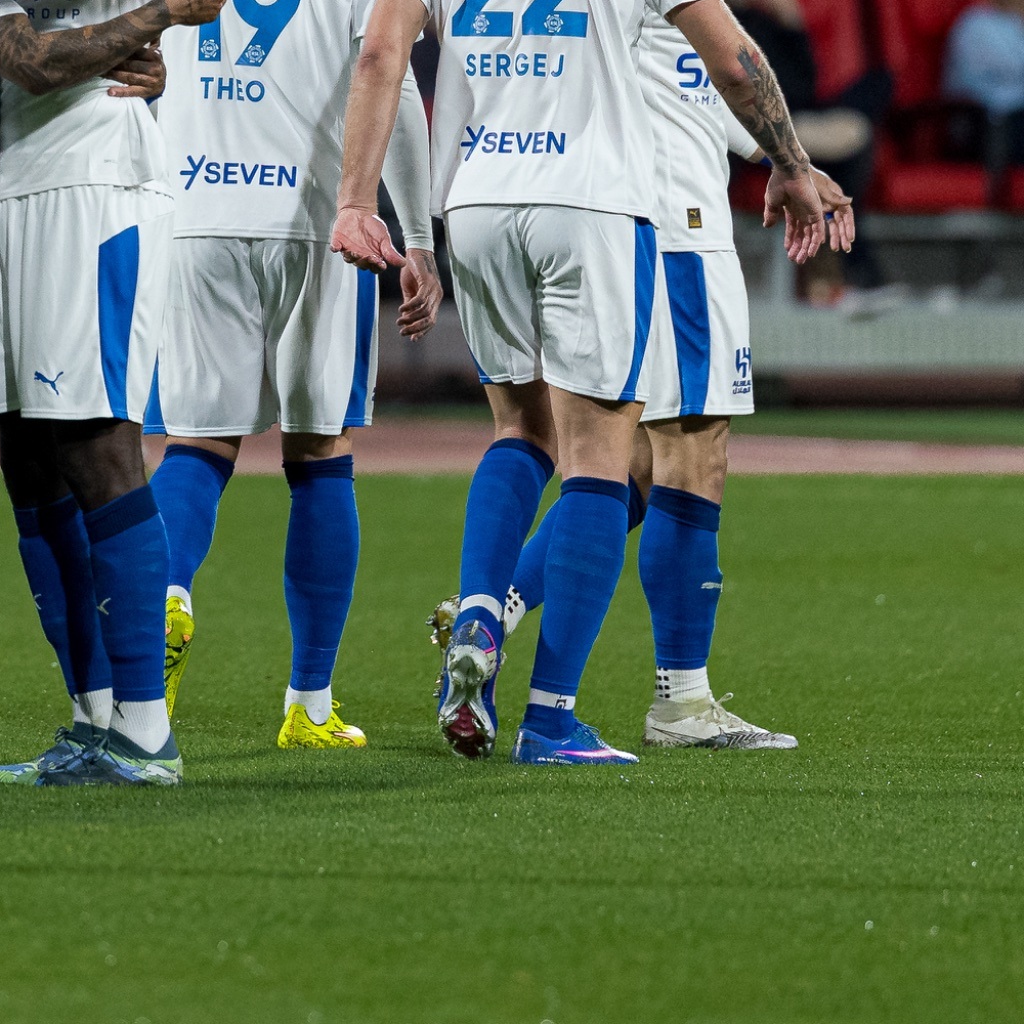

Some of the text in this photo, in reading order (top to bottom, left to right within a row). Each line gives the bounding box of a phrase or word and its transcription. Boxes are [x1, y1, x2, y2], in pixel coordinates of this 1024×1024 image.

[27, 7, 81, 20] ROUP
[465, 52, 564, 78] SERGEJ
[200, 76, 265, 103] THEO
